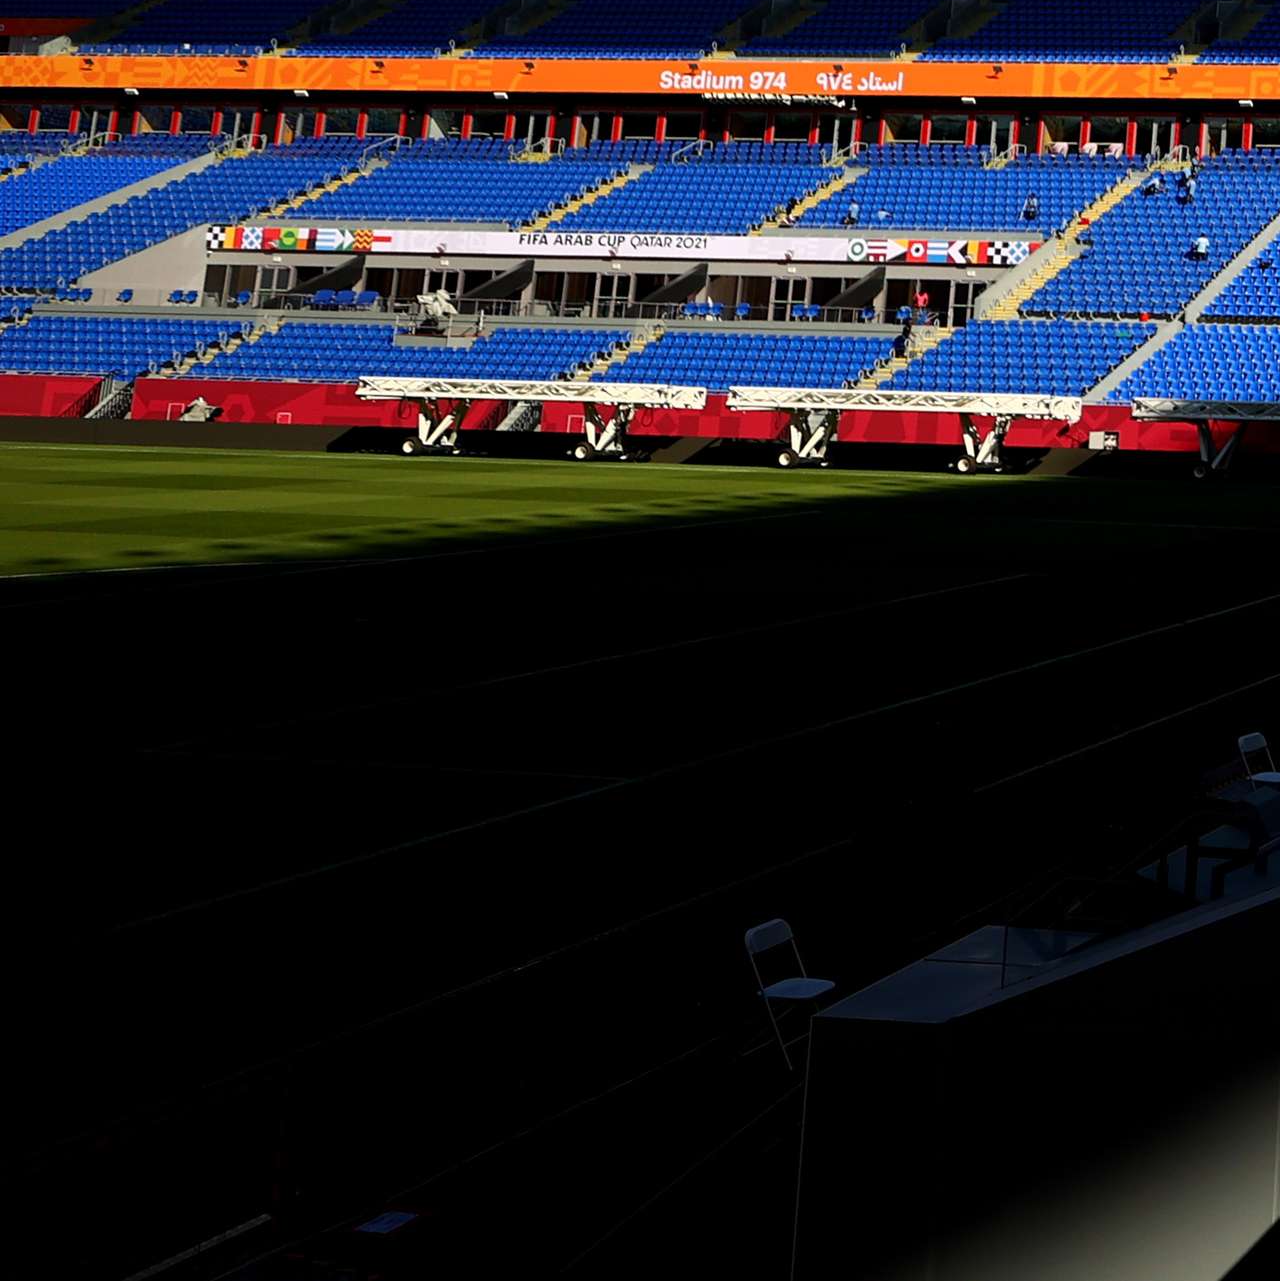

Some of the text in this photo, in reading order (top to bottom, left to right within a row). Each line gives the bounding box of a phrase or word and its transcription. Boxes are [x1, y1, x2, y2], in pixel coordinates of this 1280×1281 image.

[659, 70, 787, 90] Stadium 974
[856, 72, 903, 92] استاد
[519, 234, 708, 250] FIFA ARAB CUP QATAR 2021
